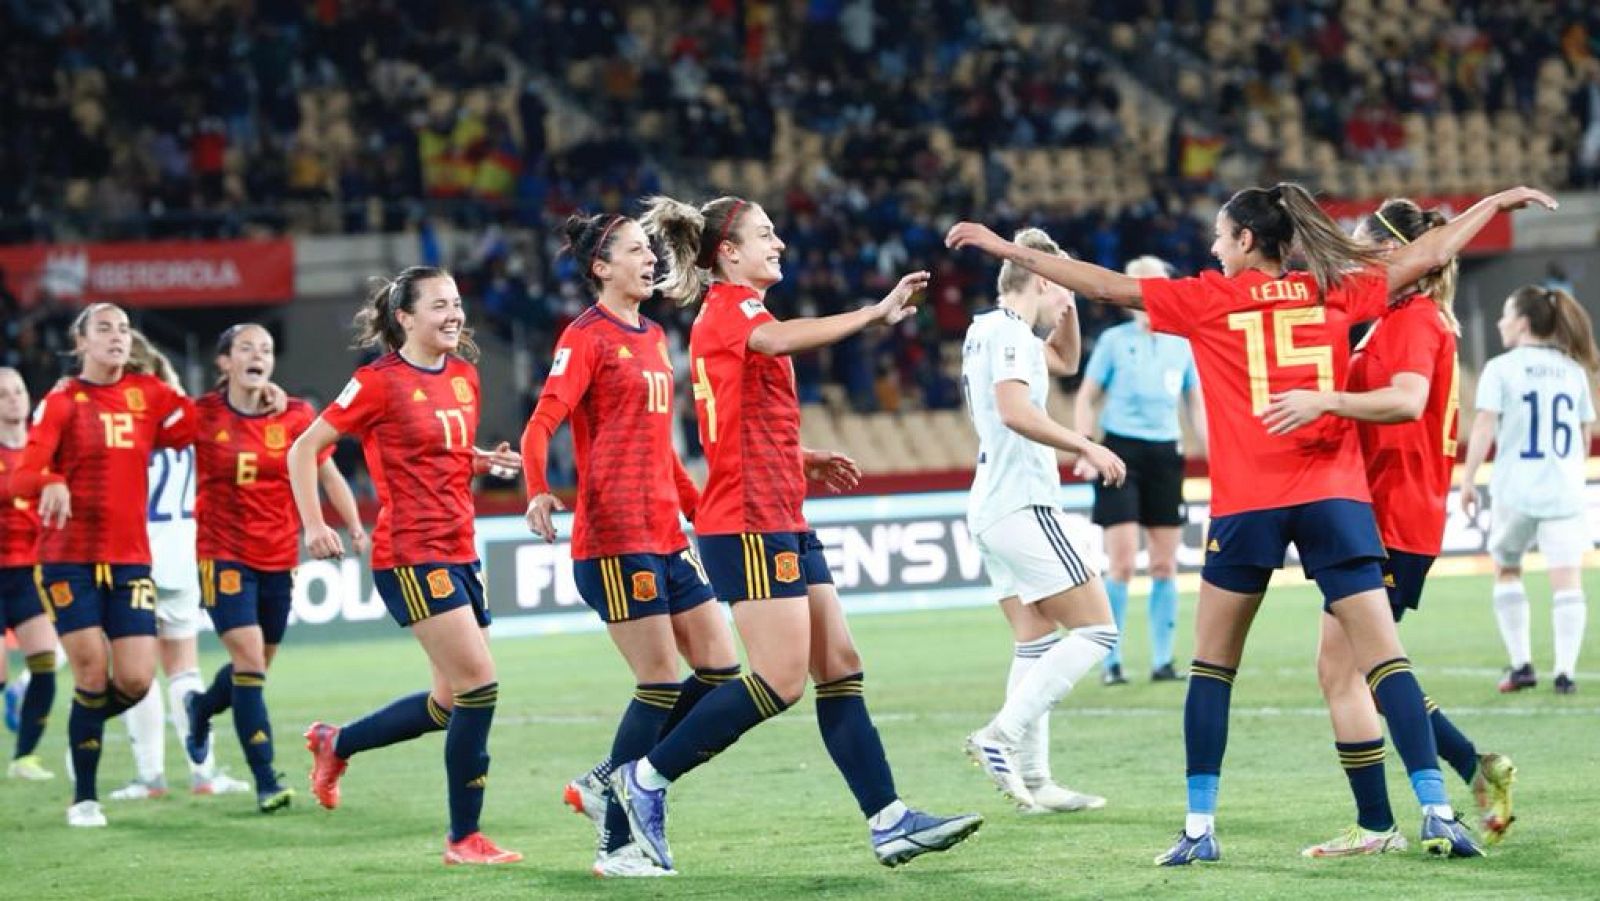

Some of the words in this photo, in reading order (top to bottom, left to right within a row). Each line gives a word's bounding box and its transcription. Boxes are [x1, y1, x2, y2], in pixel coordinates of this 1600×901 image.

[1250, 279, 1309, 301] LEILA
[1228, 305, 1334, 416] 15
[642, 370, 669, 413] 10
[100, 412, 134, 448] 12
[435, 409, 468, 450] 17
[1519, 390, 1574, 459] 16
[238, 452, 258, 485] 6
[289, 559, 387, 625] OL
[516, 543, 588, 608] FI
